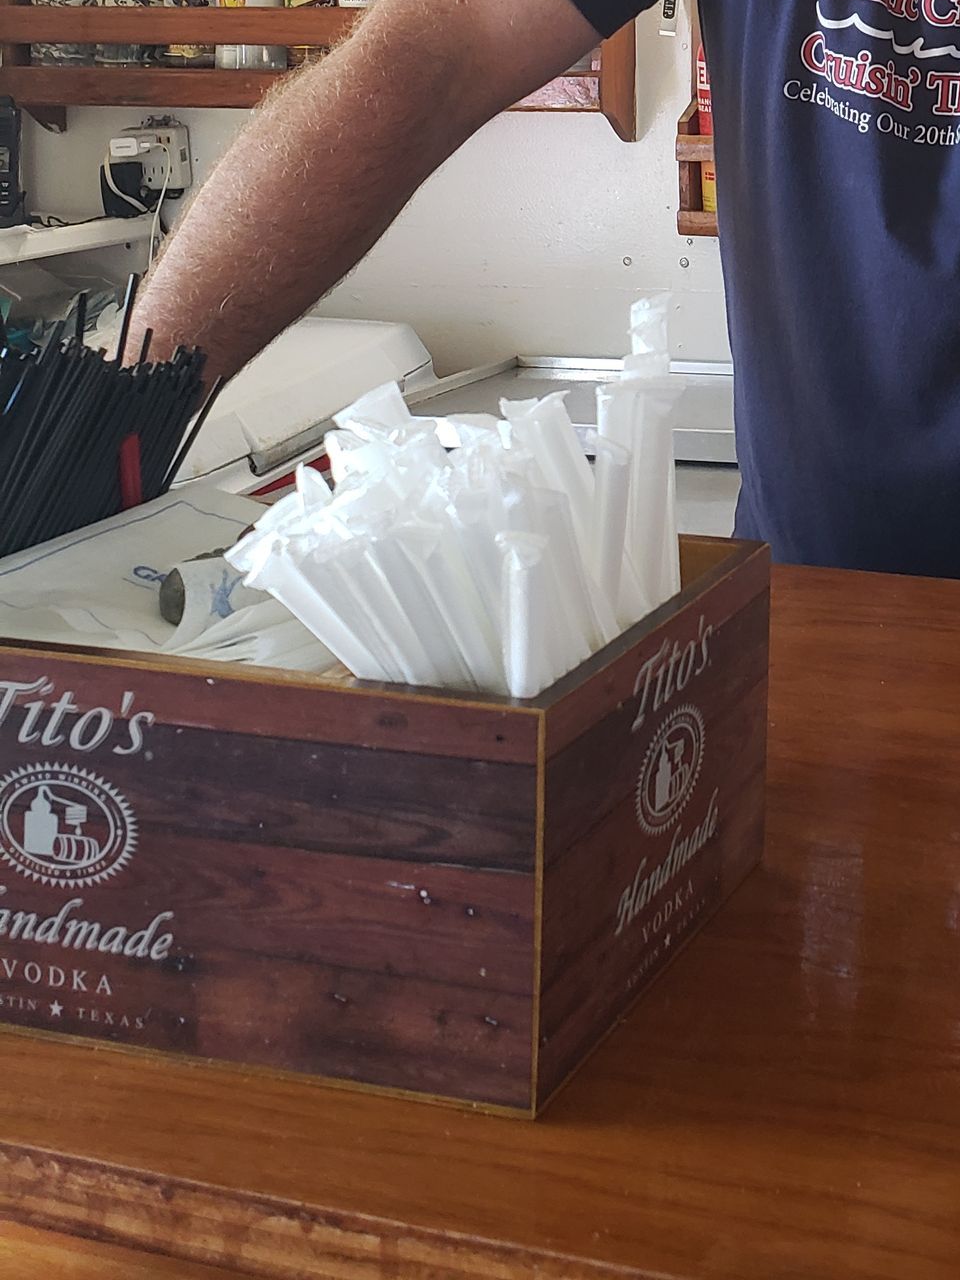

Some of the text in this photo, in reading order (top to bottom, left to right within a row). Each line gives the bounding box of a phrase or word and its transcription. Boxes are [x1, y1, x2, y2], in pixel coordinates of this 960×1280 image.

[800, 30, 922, 112] Cruisin'
[783, 79, 872, 133] Celebrating
[876, 112, 911, 142] Our
[913, 124, 955, 146] 20th
[631, 614, 713, 732] Tito's
[0, 675, 156, 757] Tito's
[14, 772, 108, 802] AWARD WINNING
[8, 846, 61, 876] DISTILLED
[76, 859, 108, 876] TIMES
[614, 786, 719, 935] Handmade
[0, 897, 175, 961] andmade
[641, 879, 694, 944] VODKA
[1, 957, 113, 996] VODKA
[0, 995, 145, 1029] TIN TEXAS
